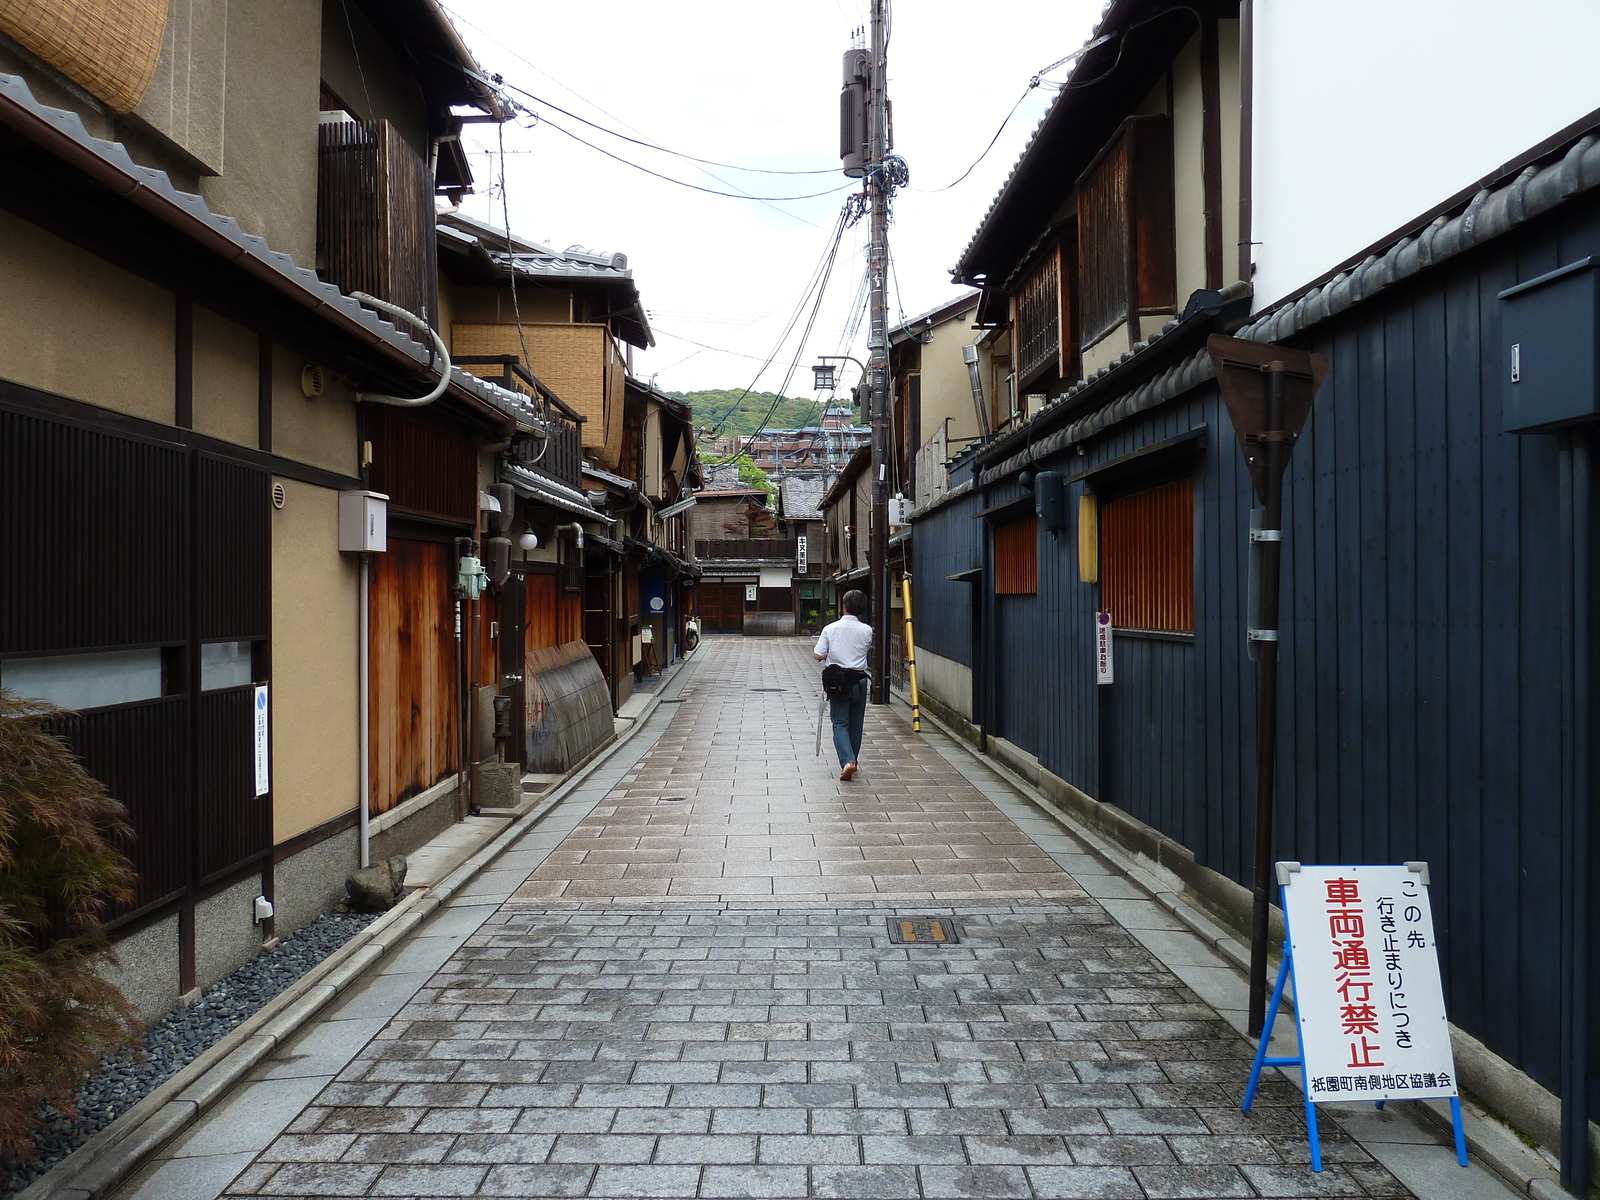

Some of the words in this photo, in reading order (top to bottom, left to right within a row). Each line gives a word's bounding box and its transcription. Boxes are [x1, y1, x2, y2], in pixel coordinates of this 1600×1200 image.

[1402, 880, 1425, 949] この先
[1324, 877, 1385, 1068] 車両通行禁止
[1376, 896, 1413, 1050] 行き止まりにつき
[1311, 1072, 1452, 1093] 祇園町南側地区協議会
